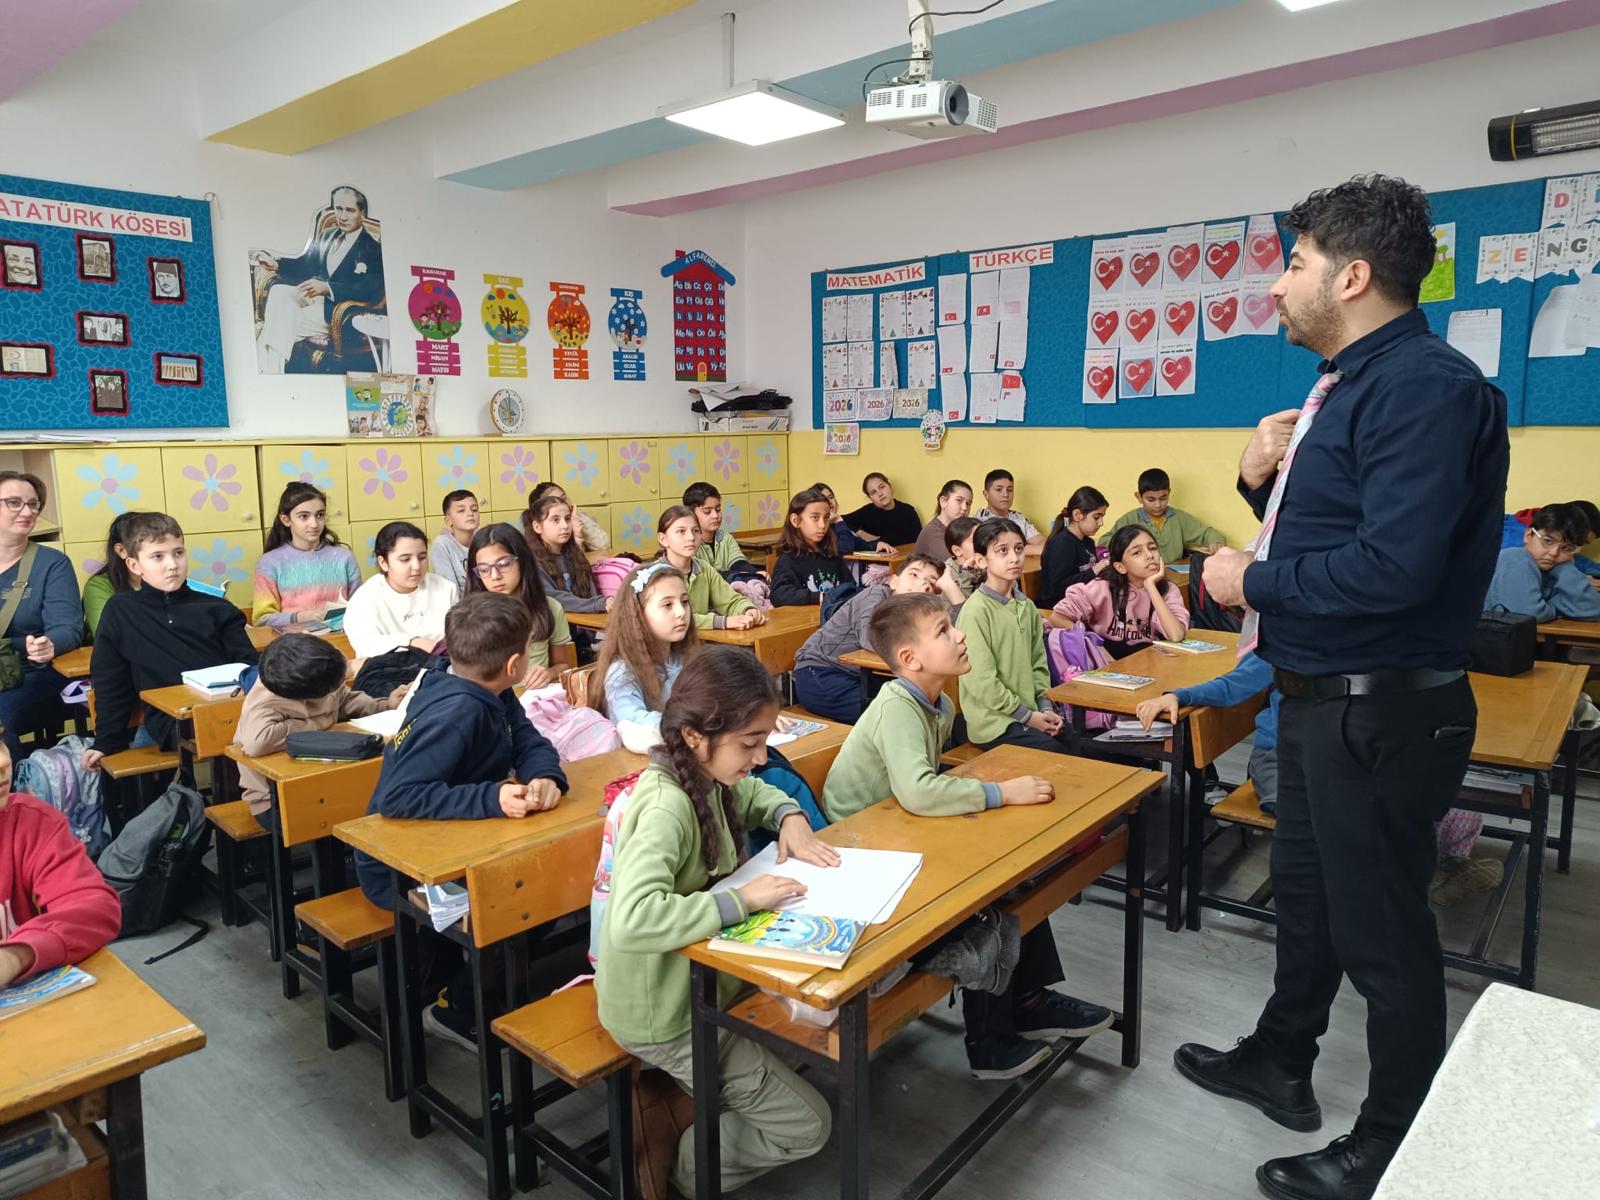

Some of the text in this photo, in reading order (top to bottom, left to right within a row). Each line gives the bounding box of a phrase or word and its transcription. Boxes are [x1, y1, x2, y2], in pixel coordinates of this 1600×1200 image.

[0, 199, 187, 238] ATATÜRK KÖŞESİ
[972, 247, 1053, 268] TÜRKÇE
[827, 265, 924, 288] MATEMATİK
[830, 399, 853, 412] 2026
[867, 400, 884, 409] 2026
[902, 399, 920, 408] 2026
